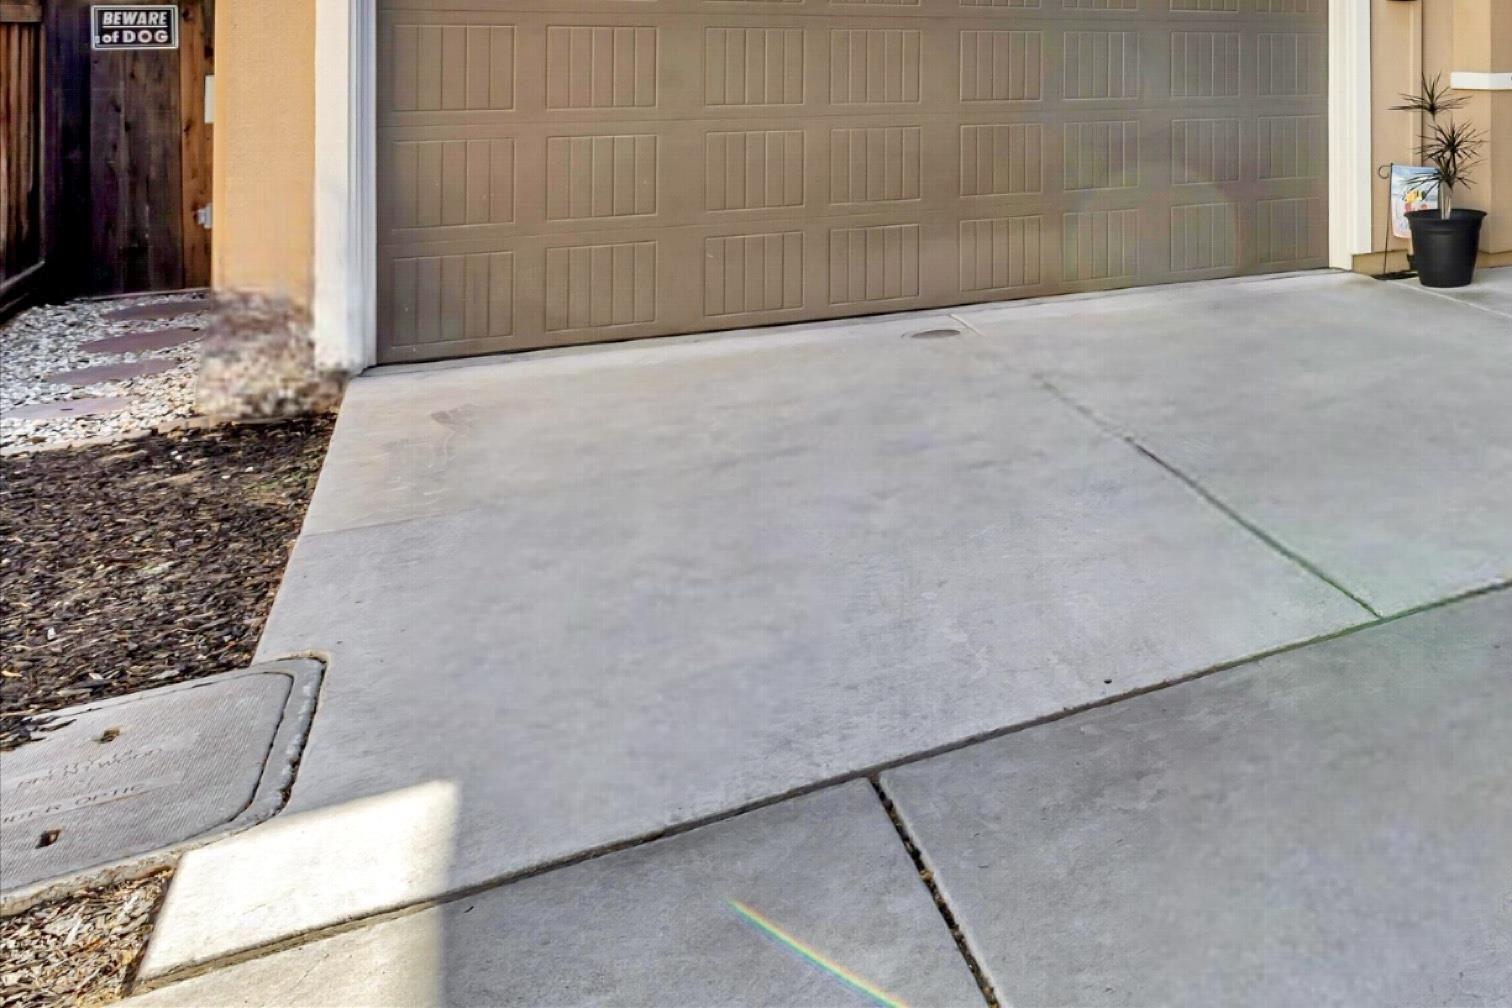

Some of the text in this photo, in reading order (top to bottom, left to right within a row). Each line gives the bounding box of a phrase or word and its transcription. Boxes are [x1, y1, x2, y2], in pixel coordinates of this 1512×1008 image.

[102, 11, 168, 26] BEWARE
[101, 29, 169, 44] of DOG
